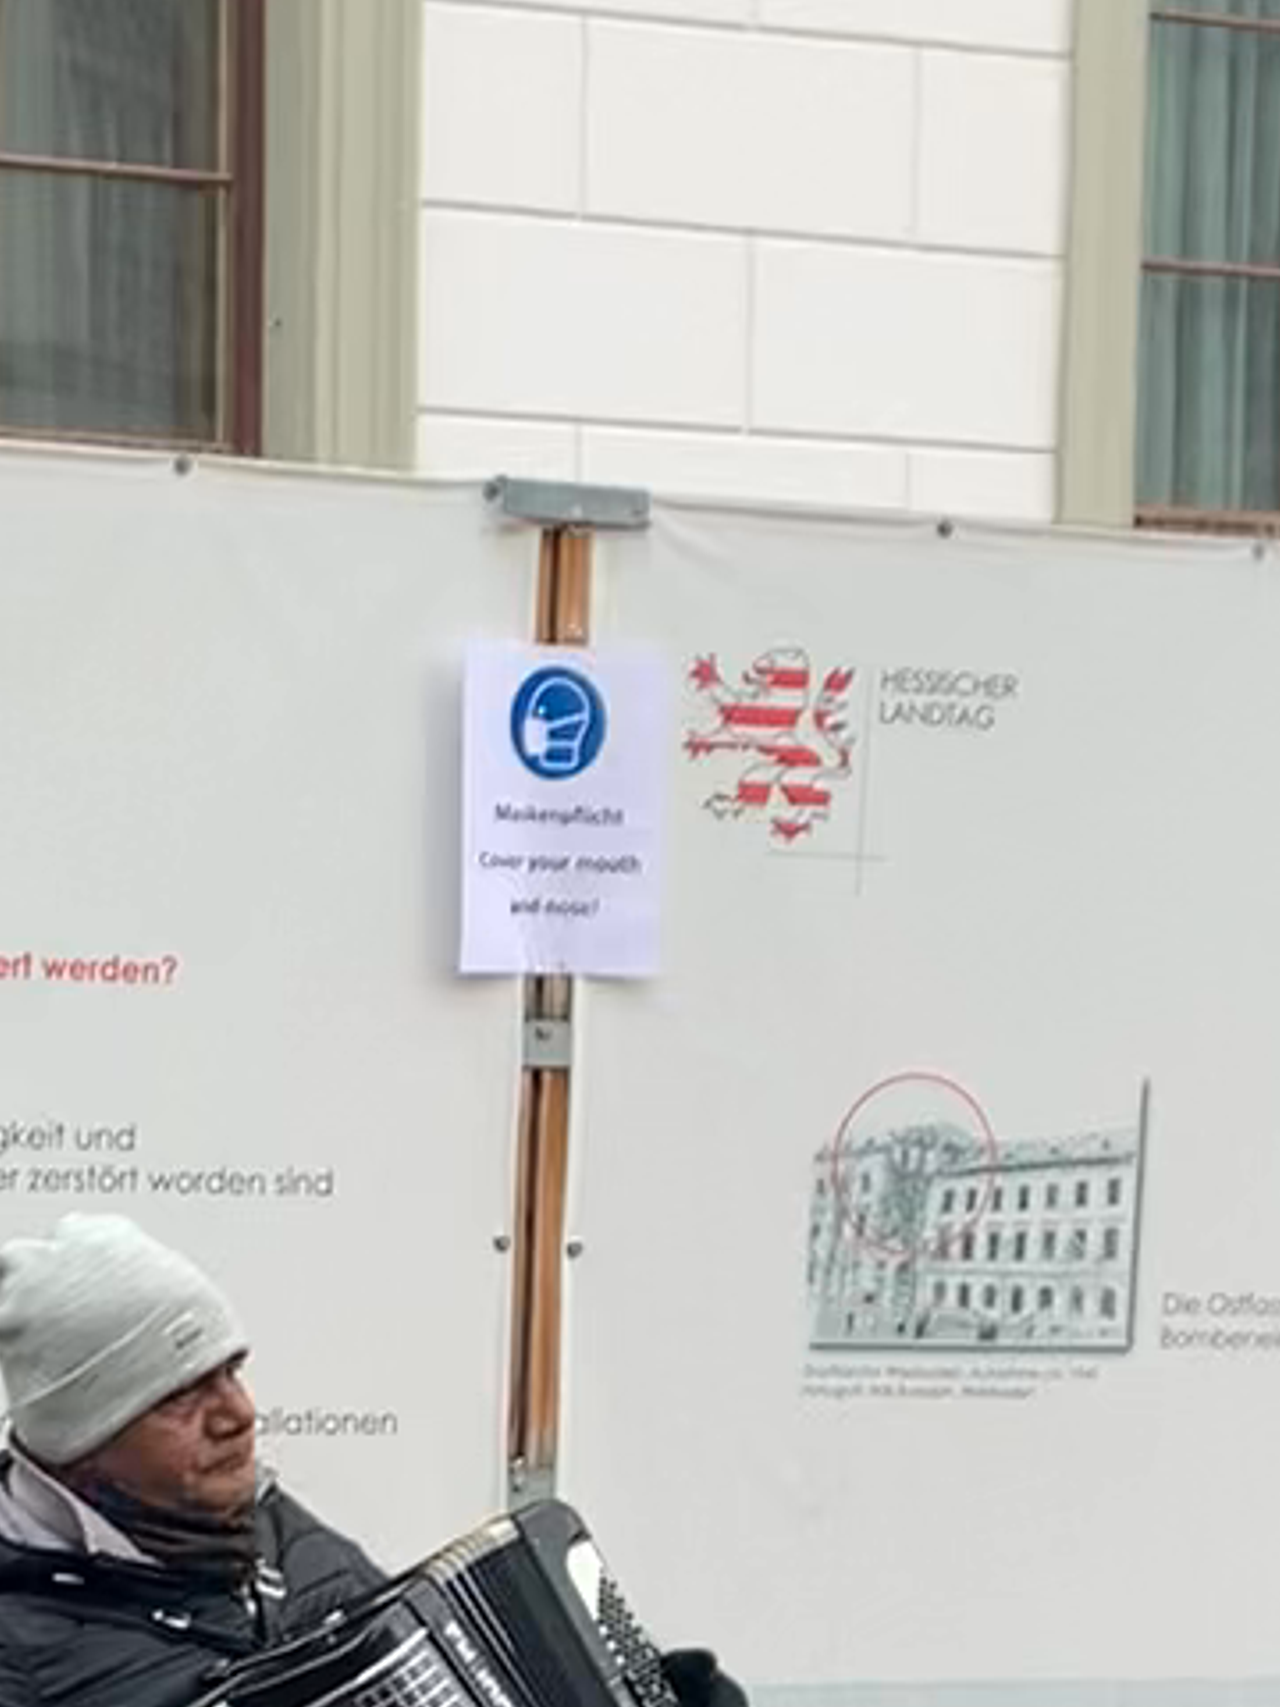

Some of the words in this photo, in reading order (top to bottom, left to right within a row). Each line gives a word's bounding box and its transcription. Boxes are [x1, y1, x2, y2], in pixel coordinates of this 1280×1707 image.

[880, 669, 1019, 698] HESSISCHER
[879, 701, 994, 730] LANDTAG
[42, 955, 178, 984] werden?
[76, 1125, 136, 1151] und
[28, 1165, 138, 1193] zerstört
[149, 1167, 265, 1194] worden
[275, 1168, 334, 1197] sind
